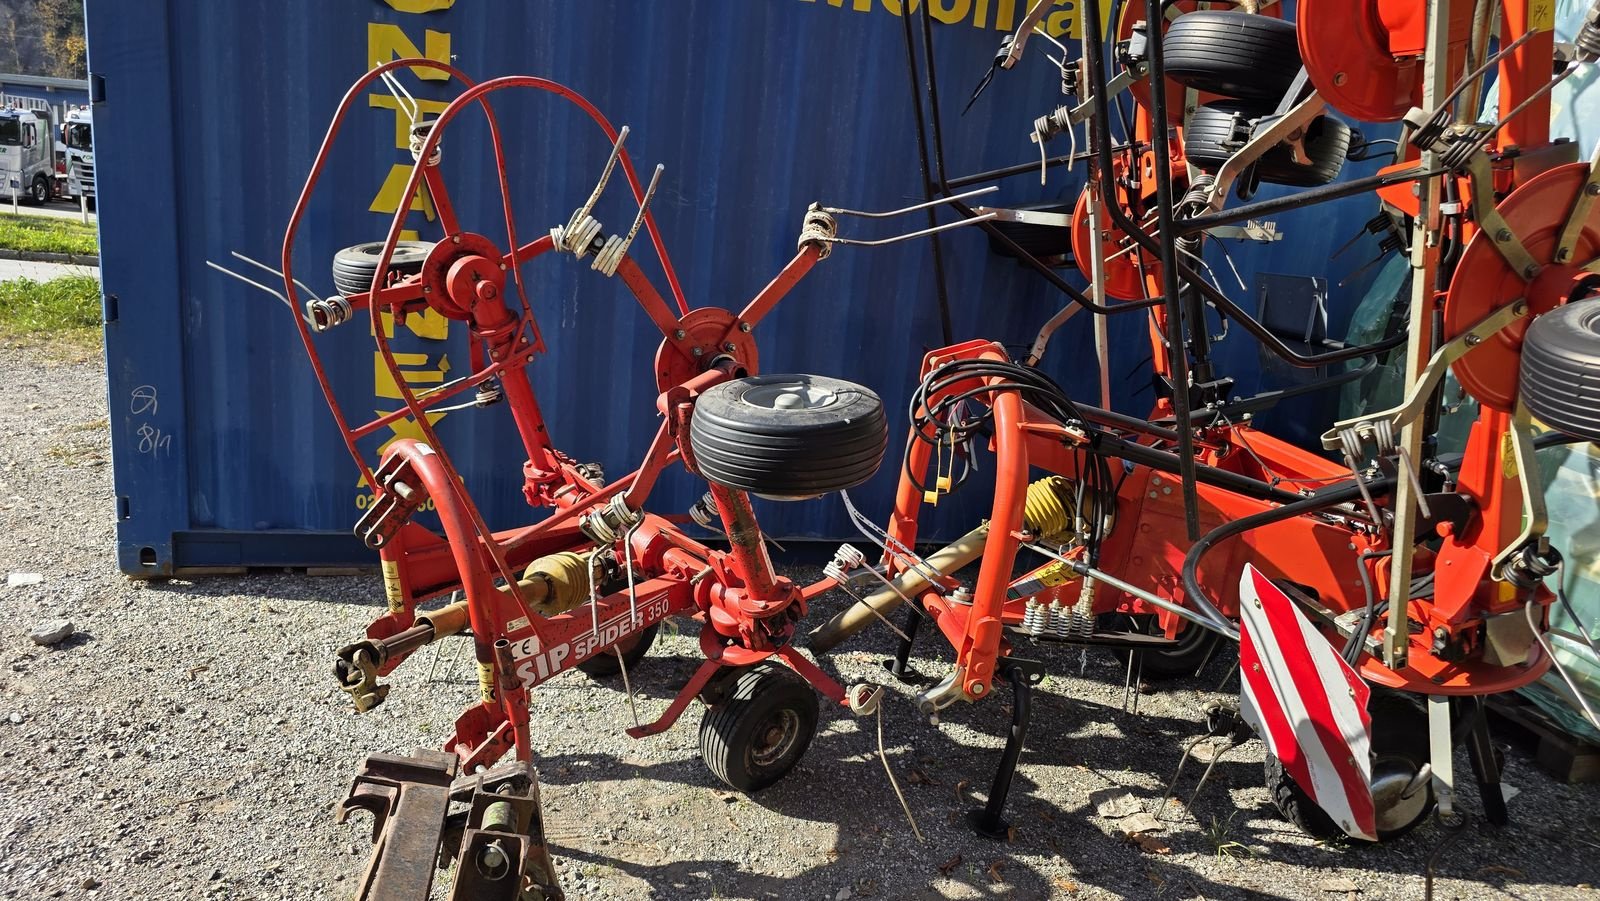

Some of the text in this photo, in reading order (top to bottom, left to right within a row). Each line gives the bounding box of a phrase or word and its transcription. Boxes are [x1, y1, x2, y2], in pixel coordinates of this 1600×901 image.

[367, 0, 456, 456] NTANEX
[516, 598, 670, 689] SIP SPIDER 350
